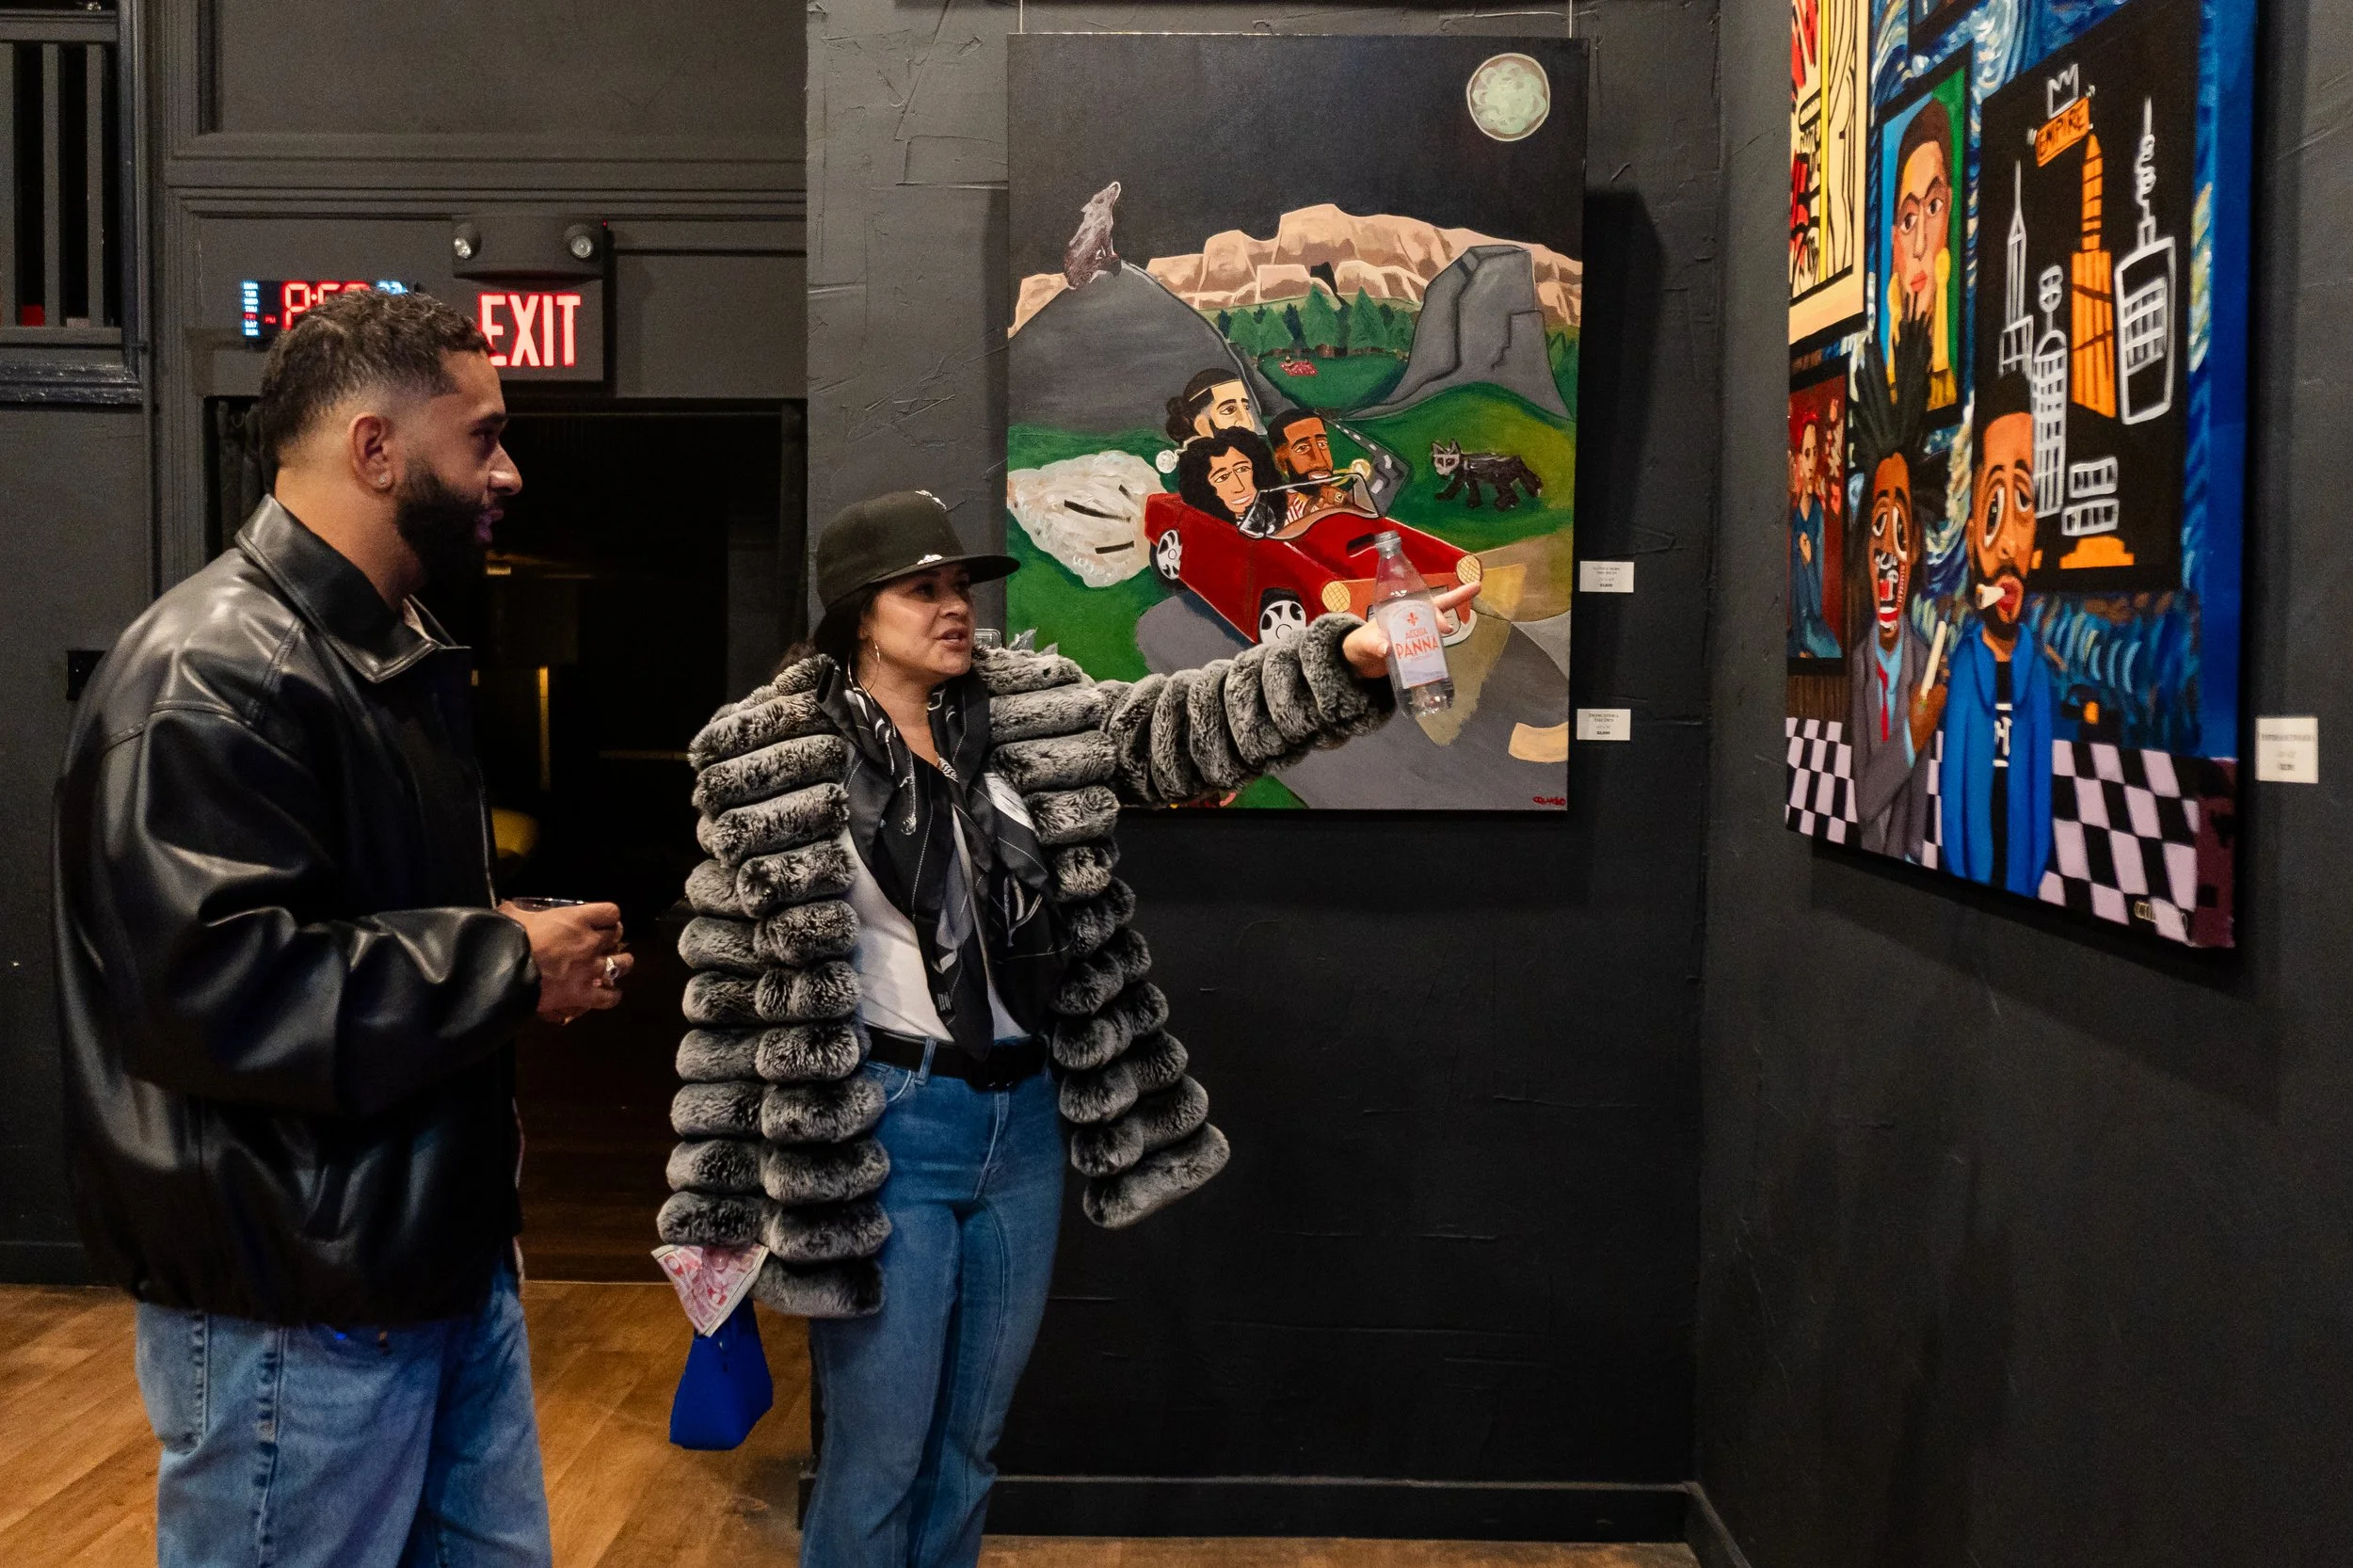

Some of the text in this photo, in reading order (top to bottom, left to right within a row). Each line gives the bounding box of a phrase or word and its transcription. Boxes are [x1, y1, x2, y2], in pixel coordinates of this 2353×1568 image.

[2037, 101, 2087, 156] EMPIRE
[265, 315, 277, 324] PM
[478, 293, 582, 367] EXIT
[1395, 636, 1439, 659] PANNA
